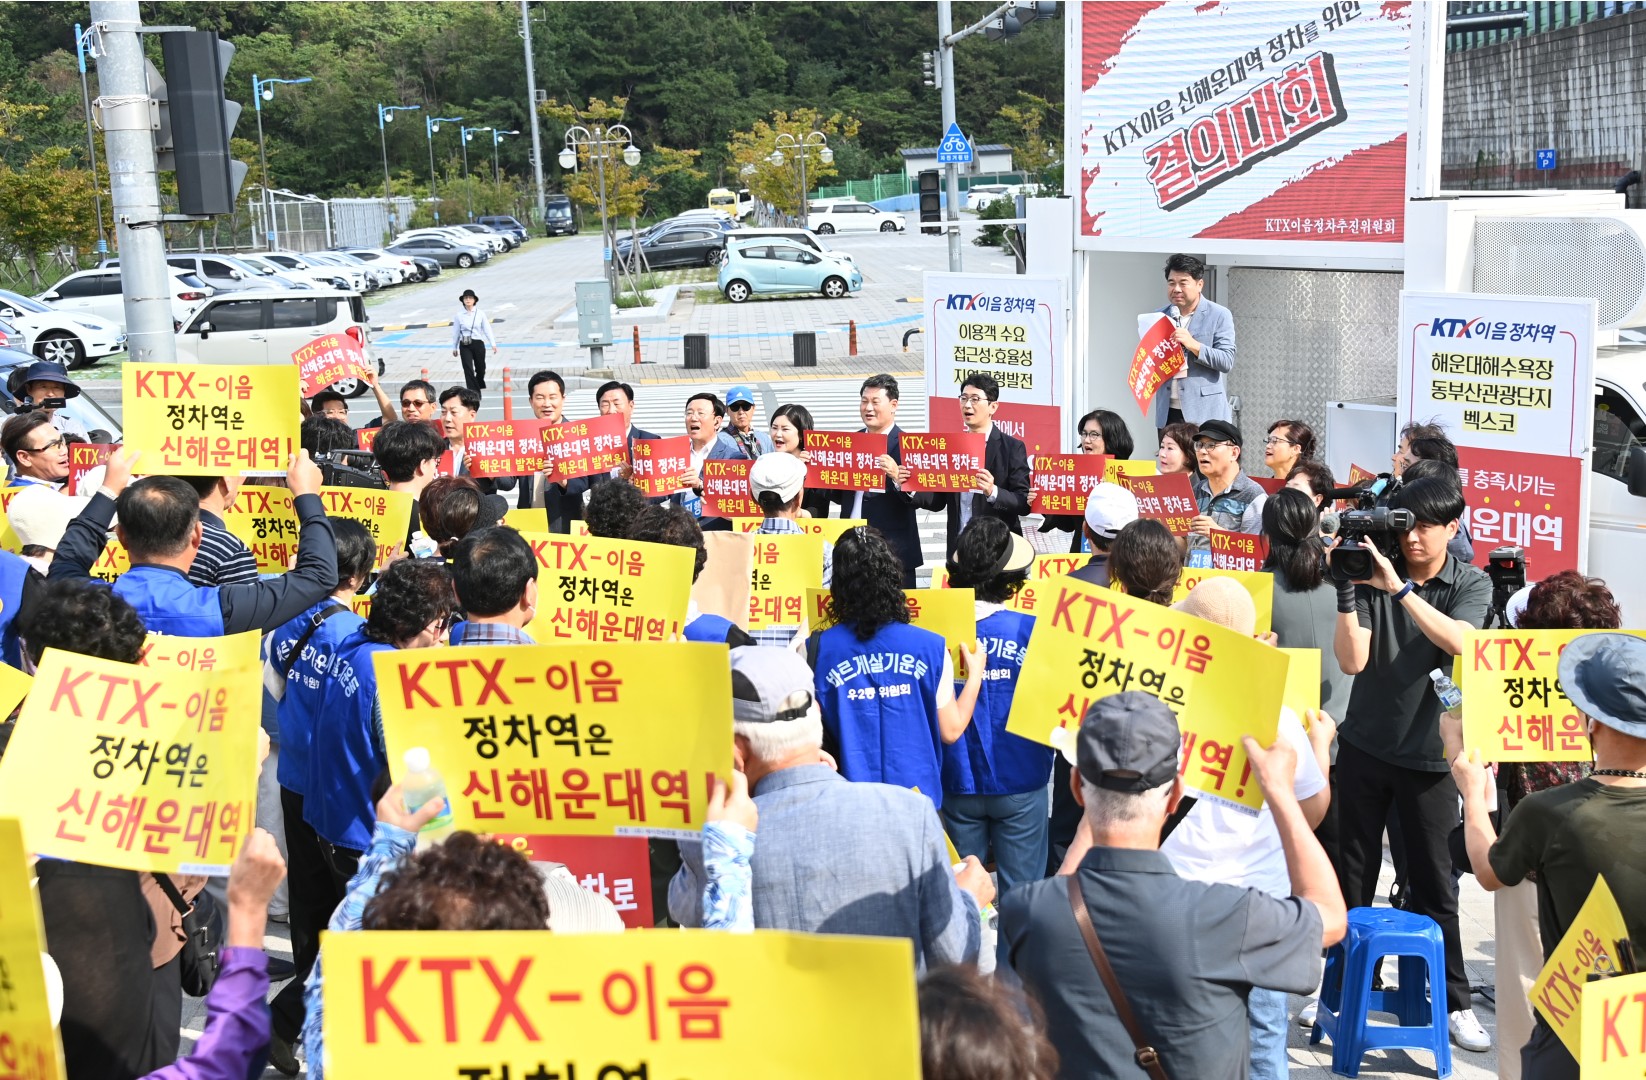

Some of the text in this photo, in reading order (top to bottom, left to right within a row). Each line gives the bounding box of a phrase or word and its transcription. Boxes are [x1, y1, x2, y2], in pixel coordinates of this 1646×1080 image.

[1102, 98, 1175, 156] KTX이음
[1176, 46, 1265, 115] 신해운대역
[1266, 20, 1320, 63] 정차를
[1144, 52, 1340, 209] 결의대회
[1542, 159, 1550, 168] P
[1264, 217, 1396, 236] KTX이음정차추진위원회
[959, 323, 1026, 343] 이용객 수요
[294, 337, 340, 365] KTX-이음
[953, 345, 1034, 367] 접근성·효율성
[301, 348, 345, 379] 신해운대역
[1431, 352, 1554, 381] 해운대해수욕장
[135, 370, 254, 400] KTX-이음
[315, 364, 345, 386] 해운대
[1431, 380, 1552, 409] 동부산관광단지
[166, 404, 245, 431] 정차역은
[1463, 410, 1515, 433] 벡스코
[466, 424, 514, 439] KTX-이음
[542, 423, 588, 443] KTX-이음
[806, 433, 853, 448] KTX-이음
[902, 435, 947, 450] KTX-이음
[467, 438, 515, 458] 신해운대역
[545, 434, 624, 461] 신해운대역 정차로
[479, 458, 511, 474] 해운대
[557, 457, 588, 476] 해운대
[657, 456, 687, 475] 정차로
[705, 463, 747, 476] KTX-이음
[809, 449, 853, 469] 신해운대역
[904, 452, 979, 471] 신해운대역 정차로
[1034, 456, 1075, 472] KTX-이음
[706, 479, 748, 496] 신해운대역
[820, 470, 884, 488] 해운대 발전을!
[917, 473, 947, 489] 해운대
[1034, 474, 1076, 492] 신해운대역
[1474, 469, 1556, 497] 충족시키는
[717, 499, 745, 514] 해운대
[1041, 495, 1071, 511] 해운대
[1163, 496, 1194, 514] 정차로
[251, 517, 299, 539] 정차역
[1211, 532, 1255, 554] KTX-이음
[531, 539, 646, 577] KTX-이음
[558, 575, 635, 608] 정차역은
[1051, 586, 1213, 674] KTX-이음
[825, 652, 929, 688] 바르게살기운동
[397, 657, 623, 711] KTX-이음
[847, 683, 912, 701] 우2동 위원회
[49, 666, 229, 733] KTX-이음
[463, 713, 614, 760] 정차역은
[89, 733, 209, 789] 정차역은
[361, 956, 732, 1046] KTX-이음
